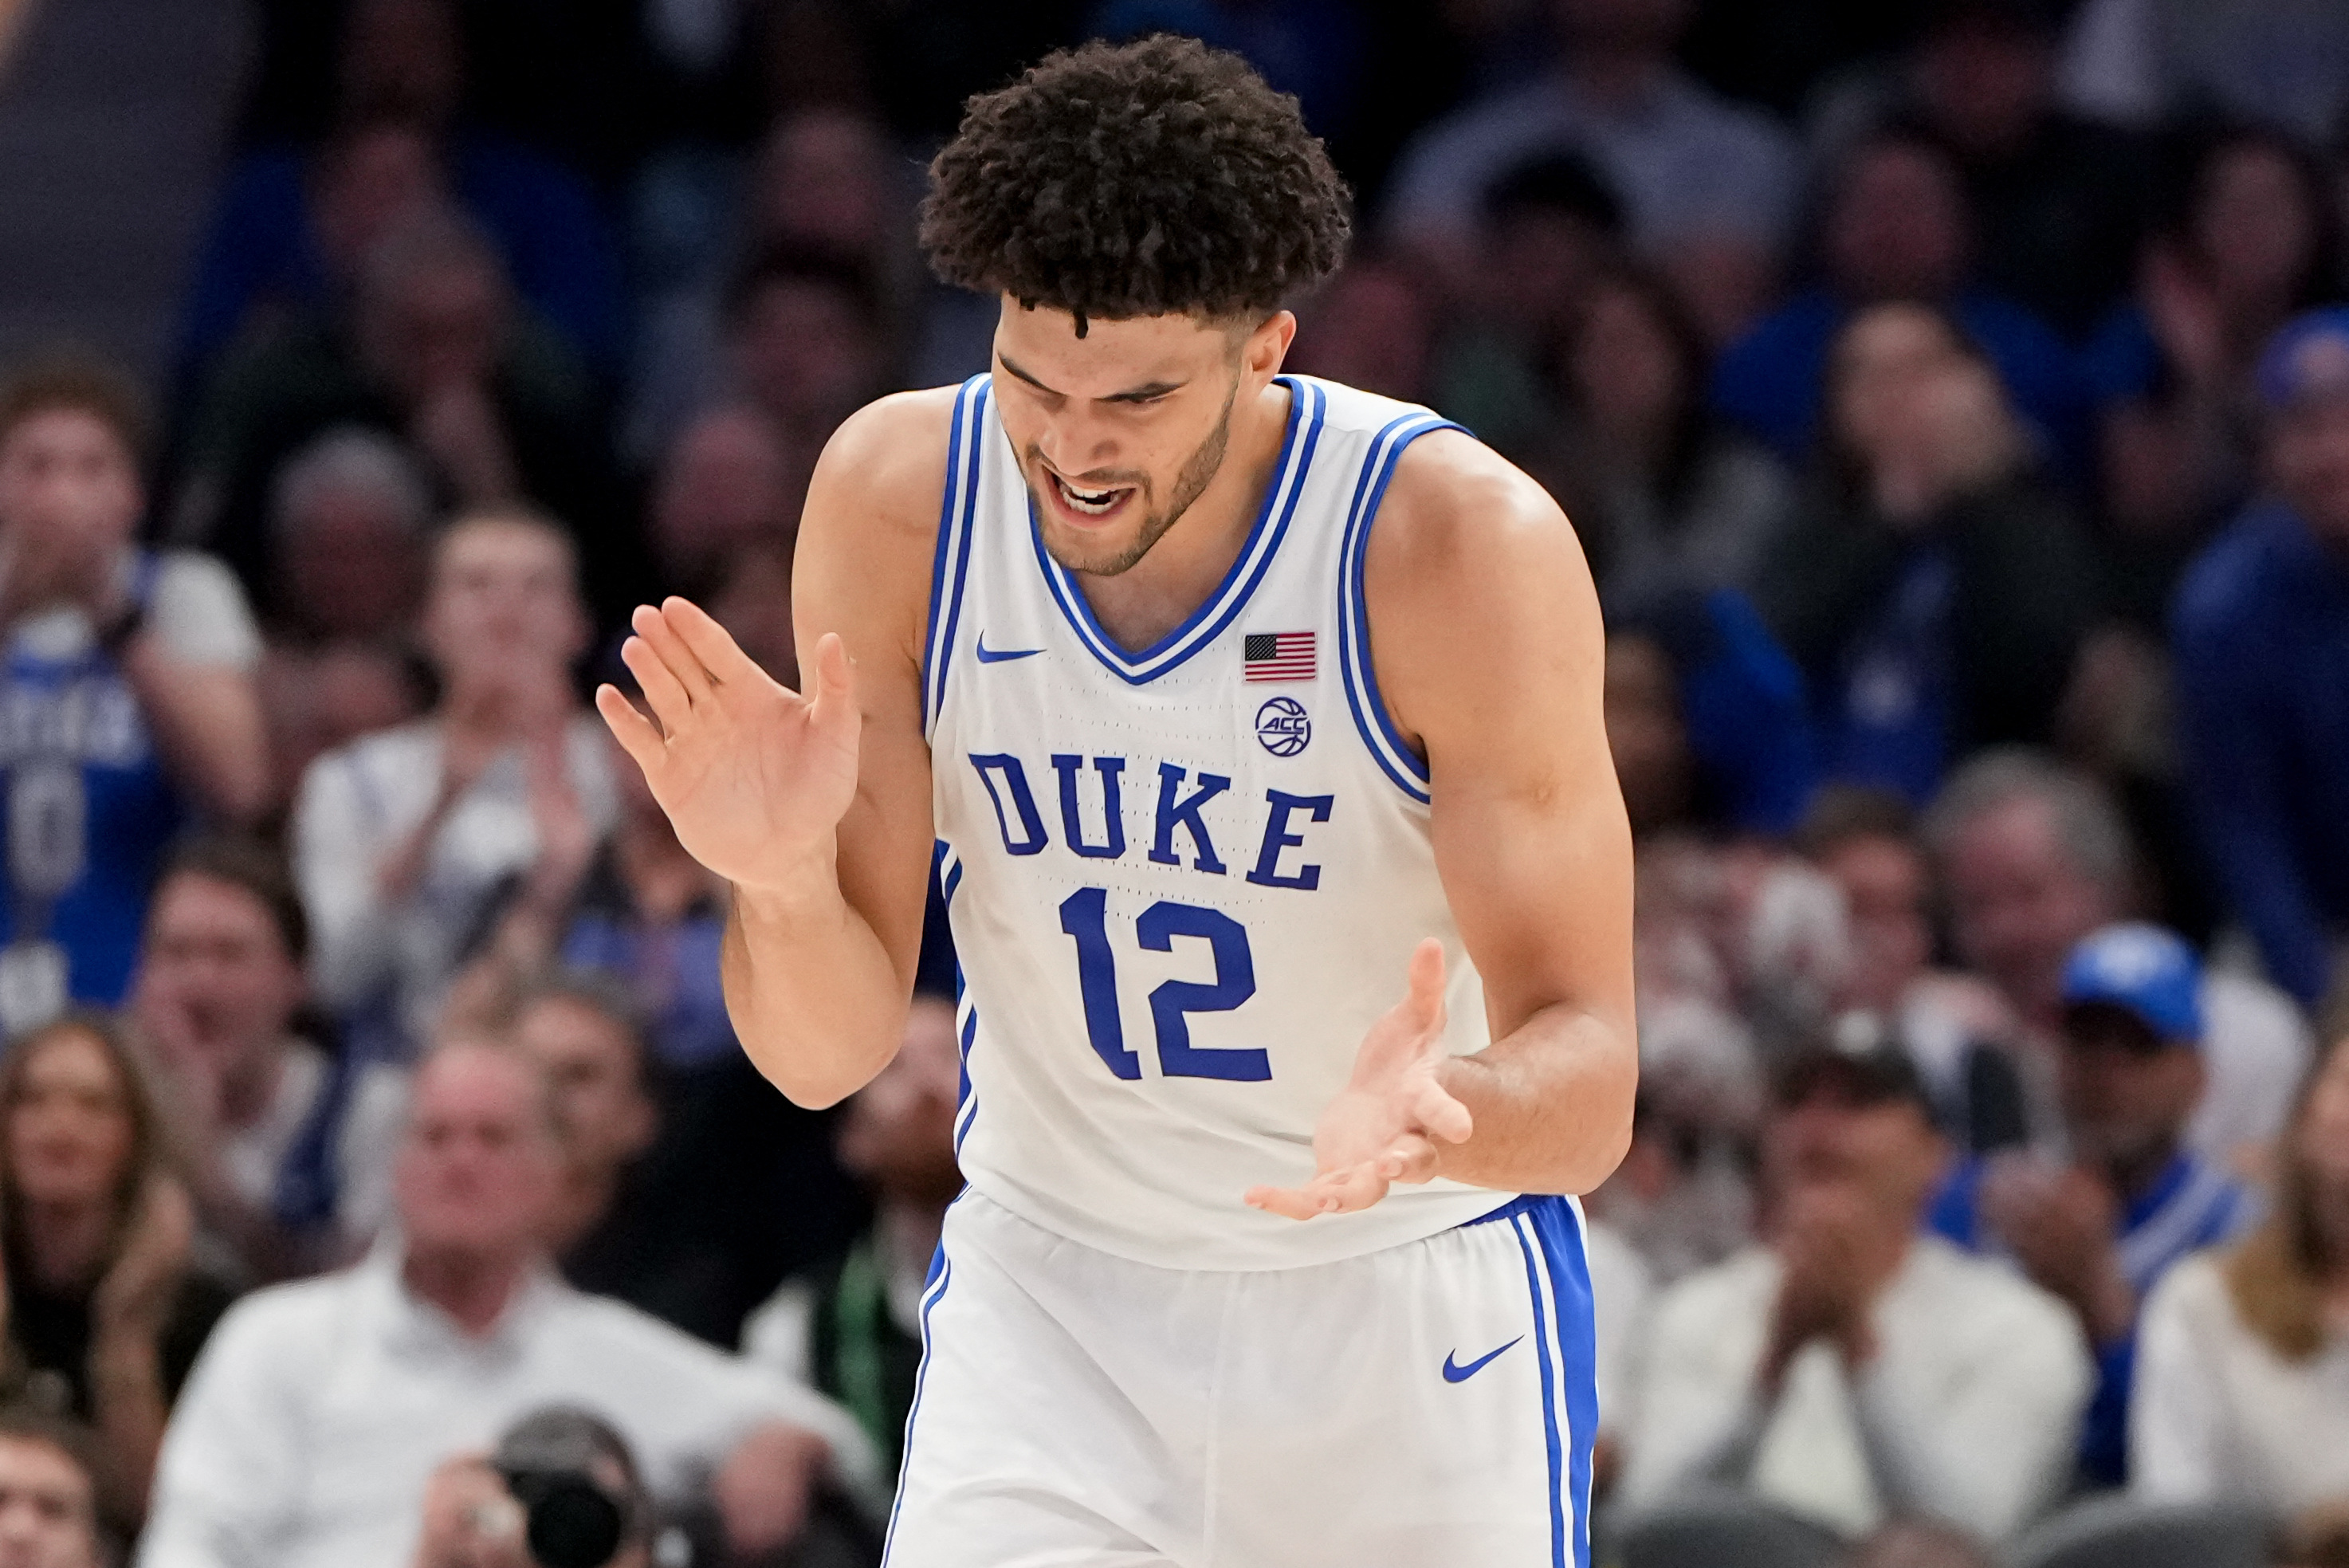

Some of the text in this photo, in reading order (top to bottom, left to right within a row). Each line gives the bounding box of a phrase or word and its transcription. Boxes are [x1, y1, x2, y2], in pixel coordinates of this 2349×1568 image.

[1264, 717, 1307, 731] ACC
[968, 752, 1334, 891] DUKE
[1059, 887, 1272, 1082] 12
